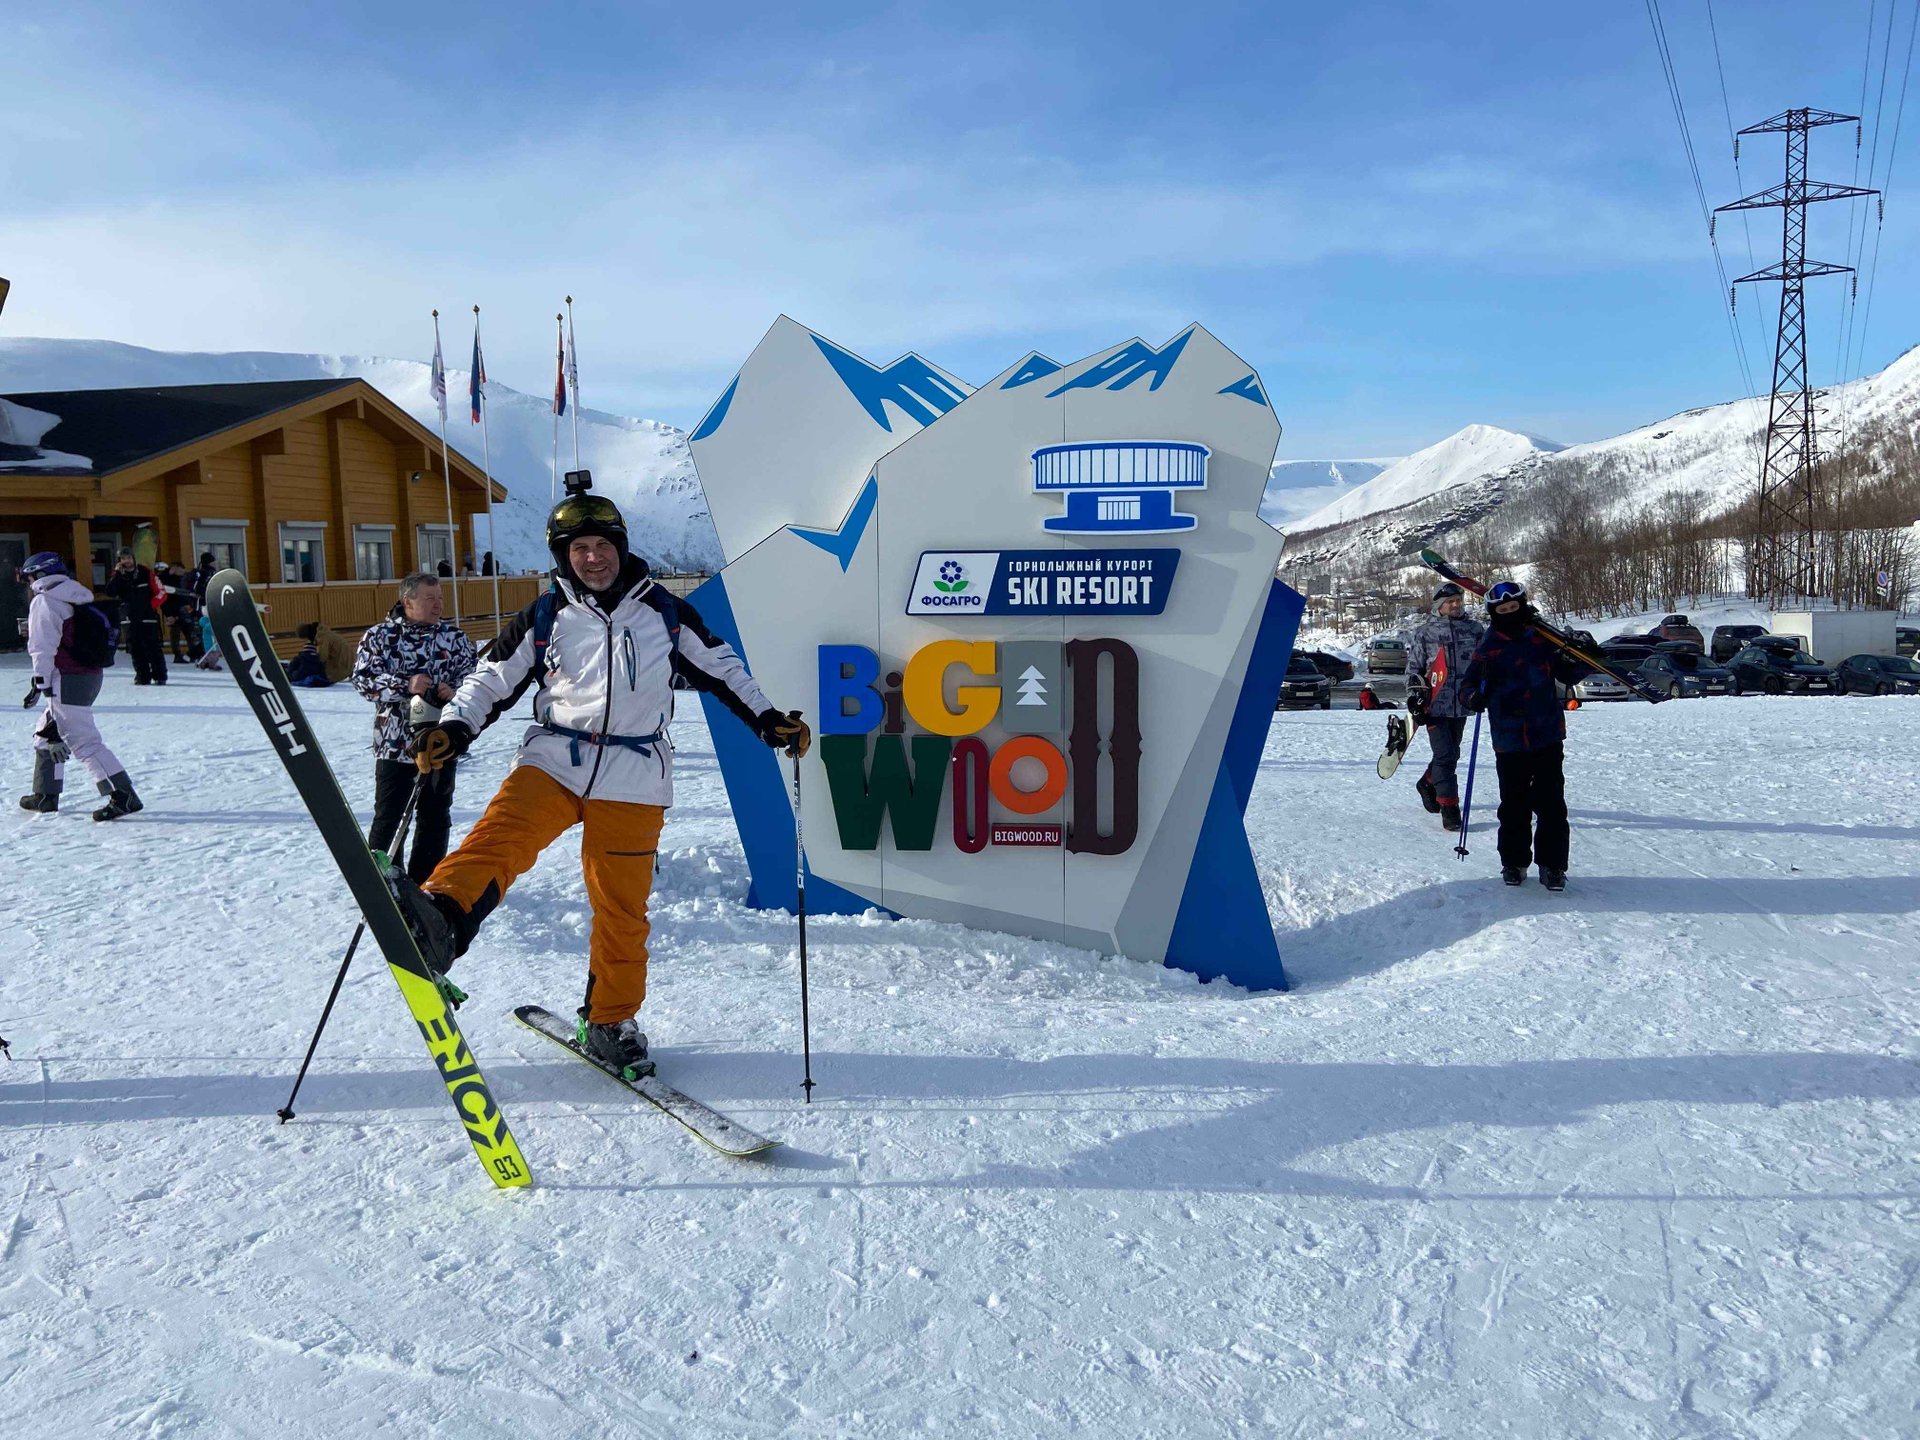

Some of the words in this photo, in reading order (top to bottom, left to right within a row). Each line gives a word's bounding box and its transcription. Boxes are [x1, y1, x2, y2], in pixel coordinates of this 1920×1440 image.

[1009, 559, 1102, 572] ГОРНОЛЫЖНЫЙ
[1107, 560, 1152, 571] КУРОРТ
[921, 595, 981, 606] ФОСАГРО
[1008, 577, 1048, 605] SKI
[1056, 576, 1153, 605] RESORT
[231, 624, 307, 757] HEAD
[820, 638, 1143, 855] WOOD
[994, 831, 1059, 842] BIGWOOD.RU
[493, 1154, 522, 1181] 93
